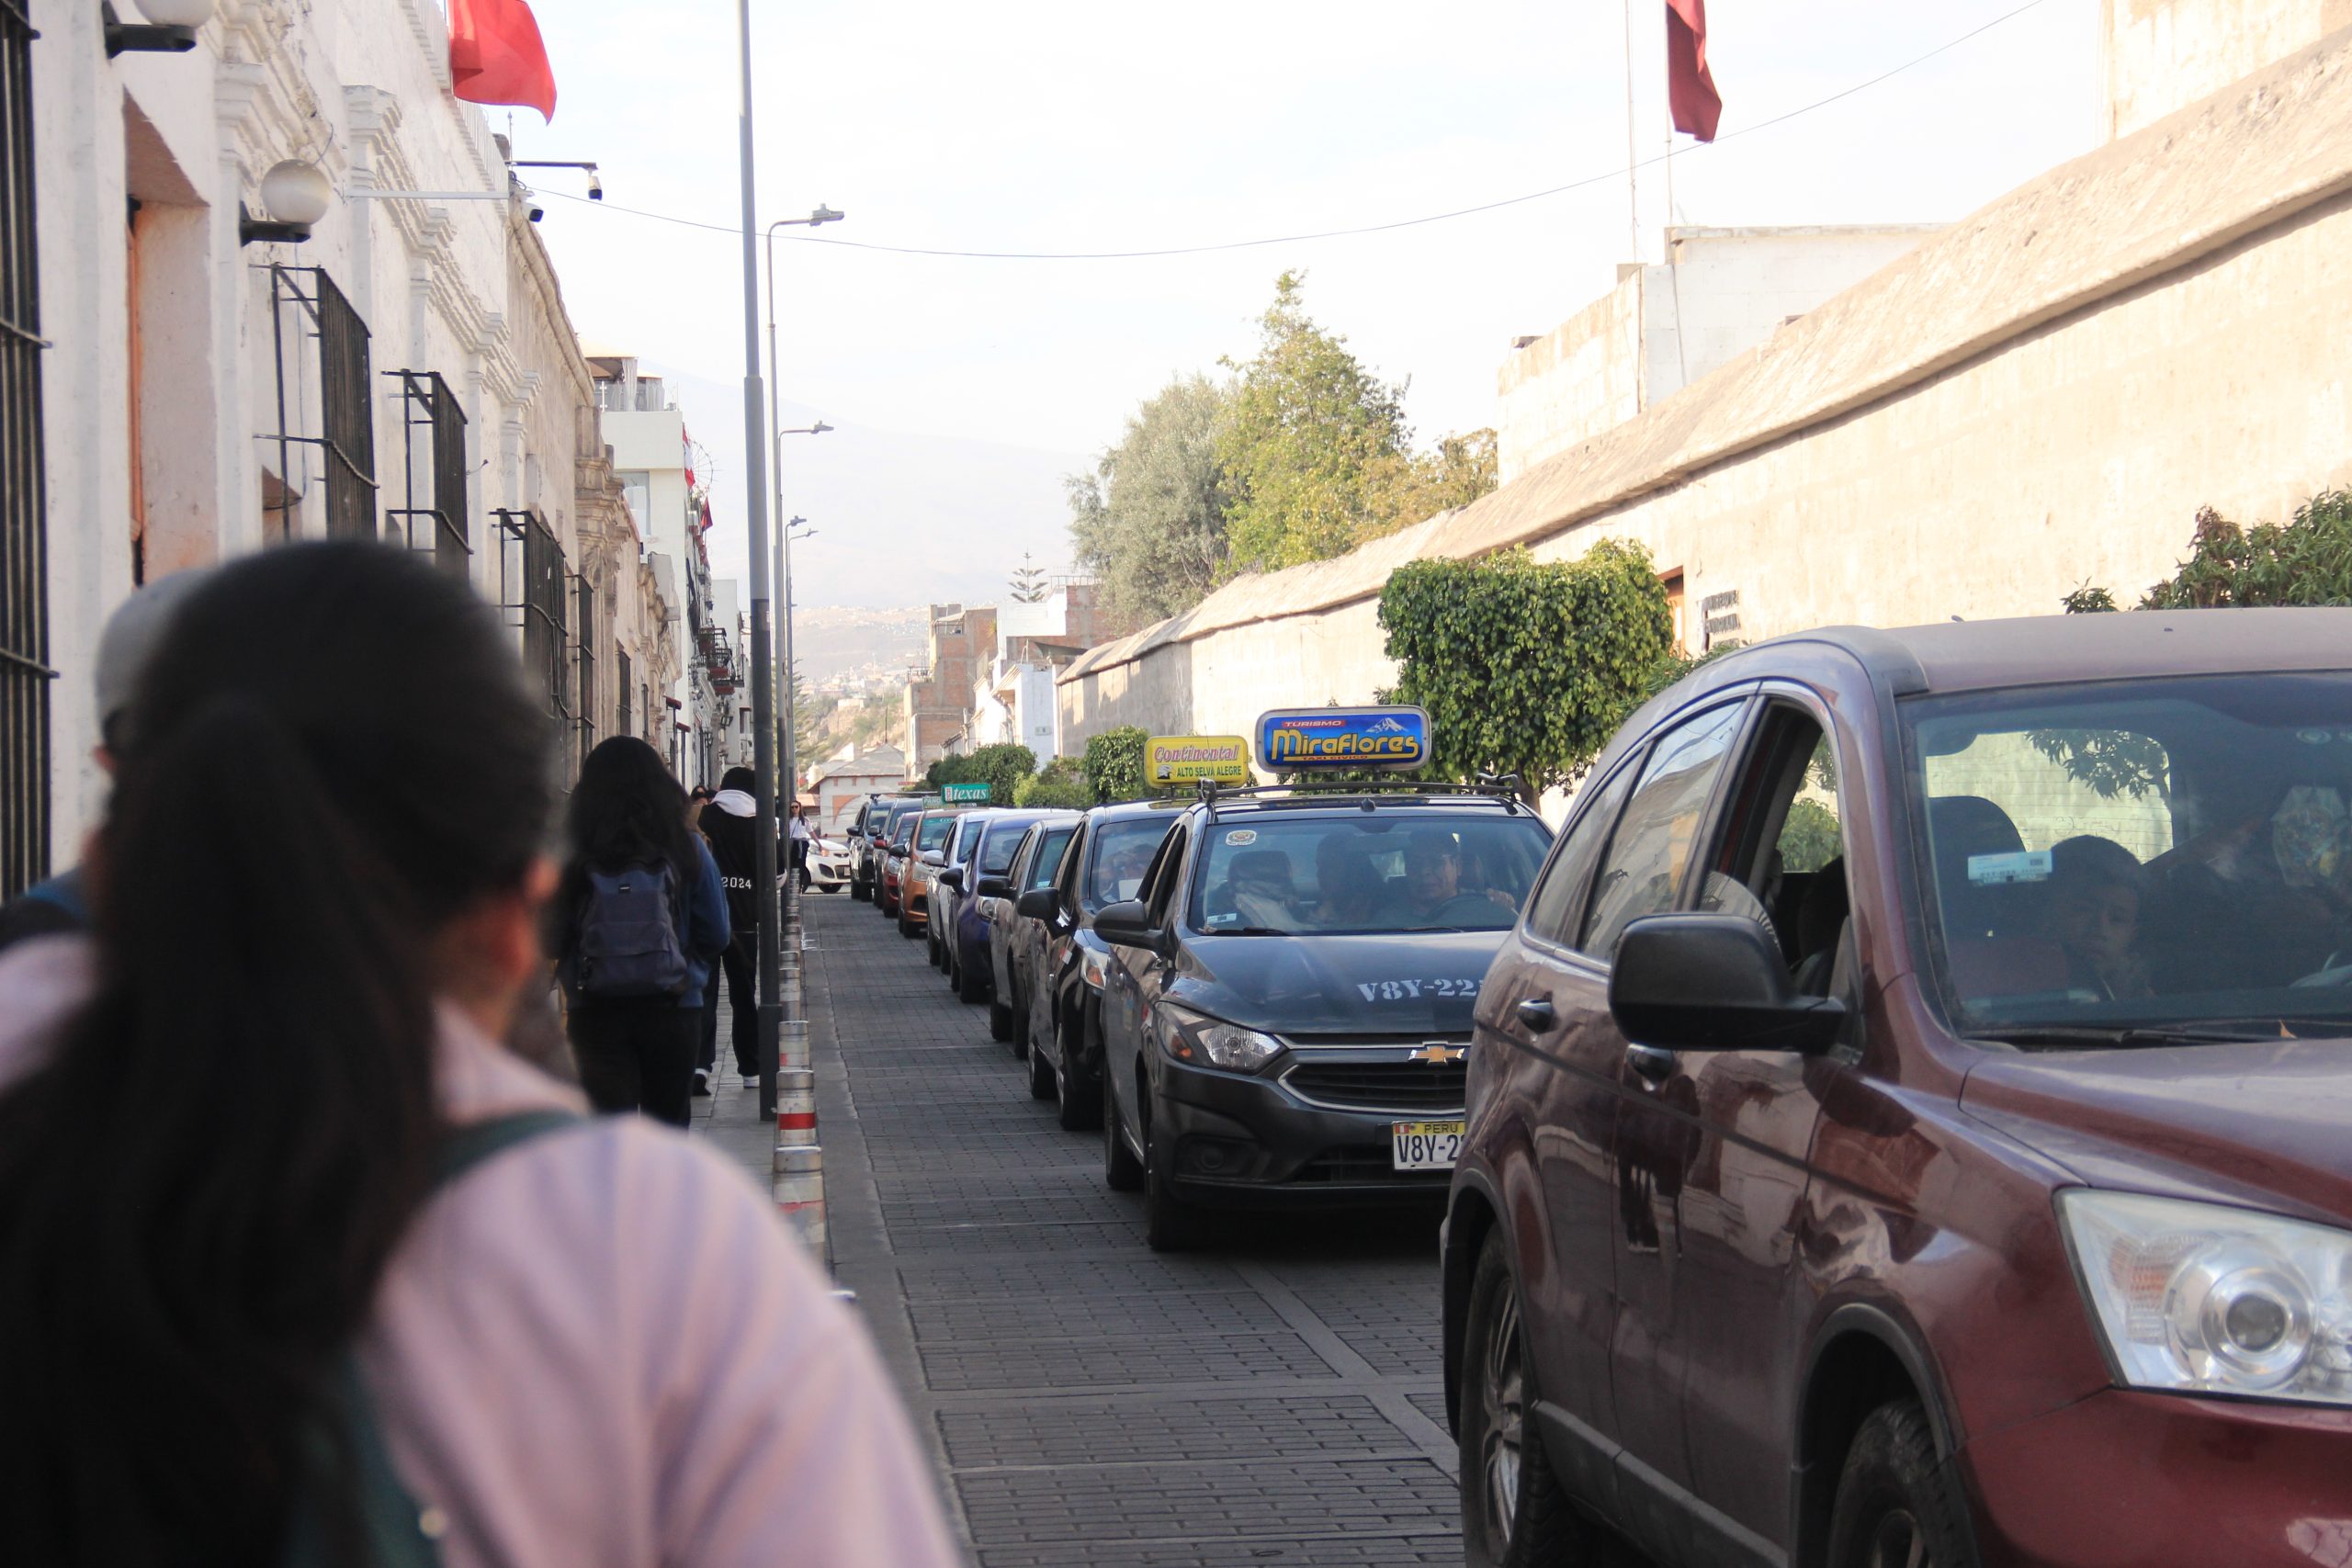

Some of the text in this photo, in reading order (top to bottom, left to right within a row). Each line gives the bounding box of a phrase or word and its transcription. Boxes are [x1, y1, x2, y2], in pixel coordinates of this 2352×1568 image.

[1271, 728, 1419, 761] Miraflores
[1154, 744, 1239, 762] Continental
[1177, 765, 1242, 777] ALTO SELVA ALEGRE
[953, 787, 987, 800] texas
[720, 876, 752, 889] 2024
[1357, 978, 1484, 1002] V8Y-22
[1424, 1123, 1458, 1134] PERU
[1396, 1134, 1465, 1163] V8Y-2
